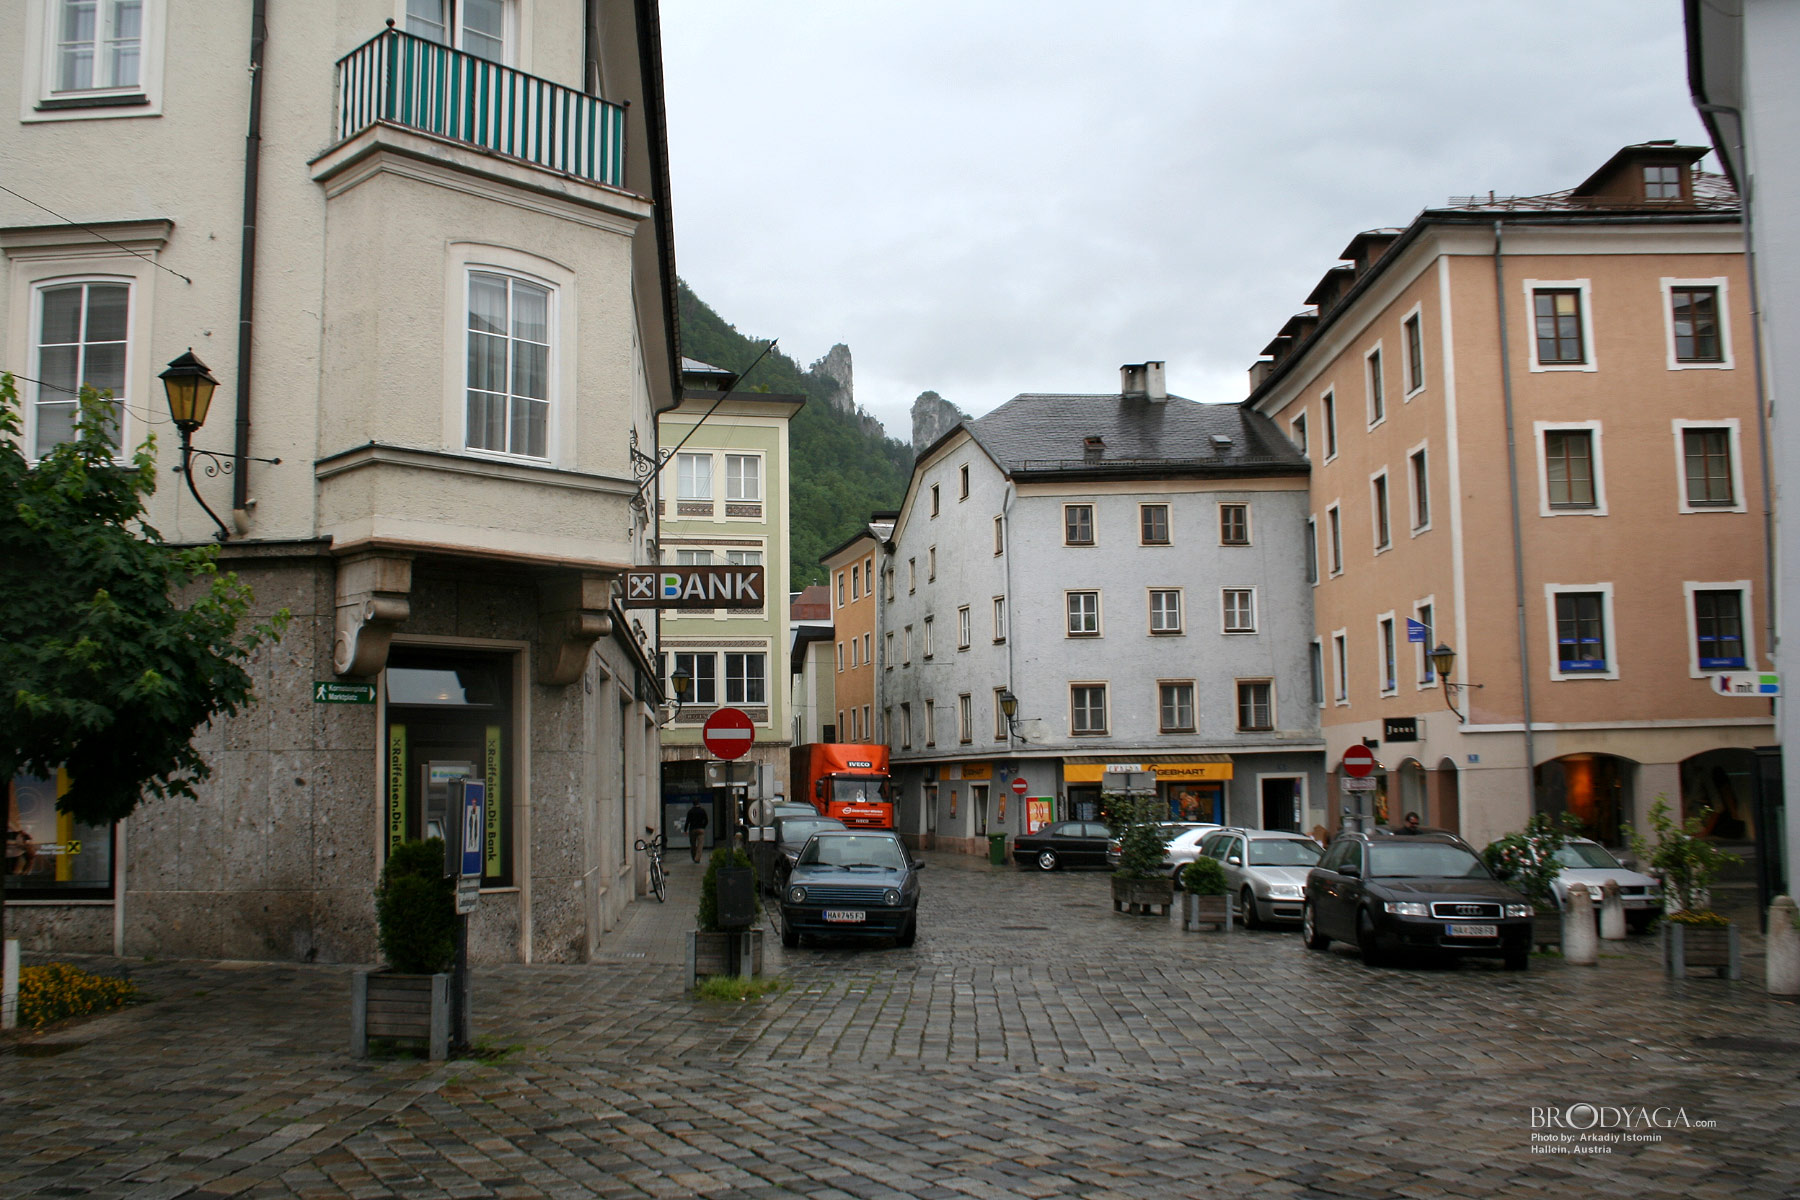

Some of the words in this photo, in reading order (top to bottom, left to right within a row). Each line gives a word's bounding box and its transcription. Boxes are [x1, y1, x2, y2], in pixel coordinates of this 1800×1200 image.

[660, 573, 759, 600] BANK
[1157, 768, 1205, 776] GEBHART
[487, 831, 497, 861] Bank
[828, 911, 836, 919] HA
[841, 911, 855, 920] 745
